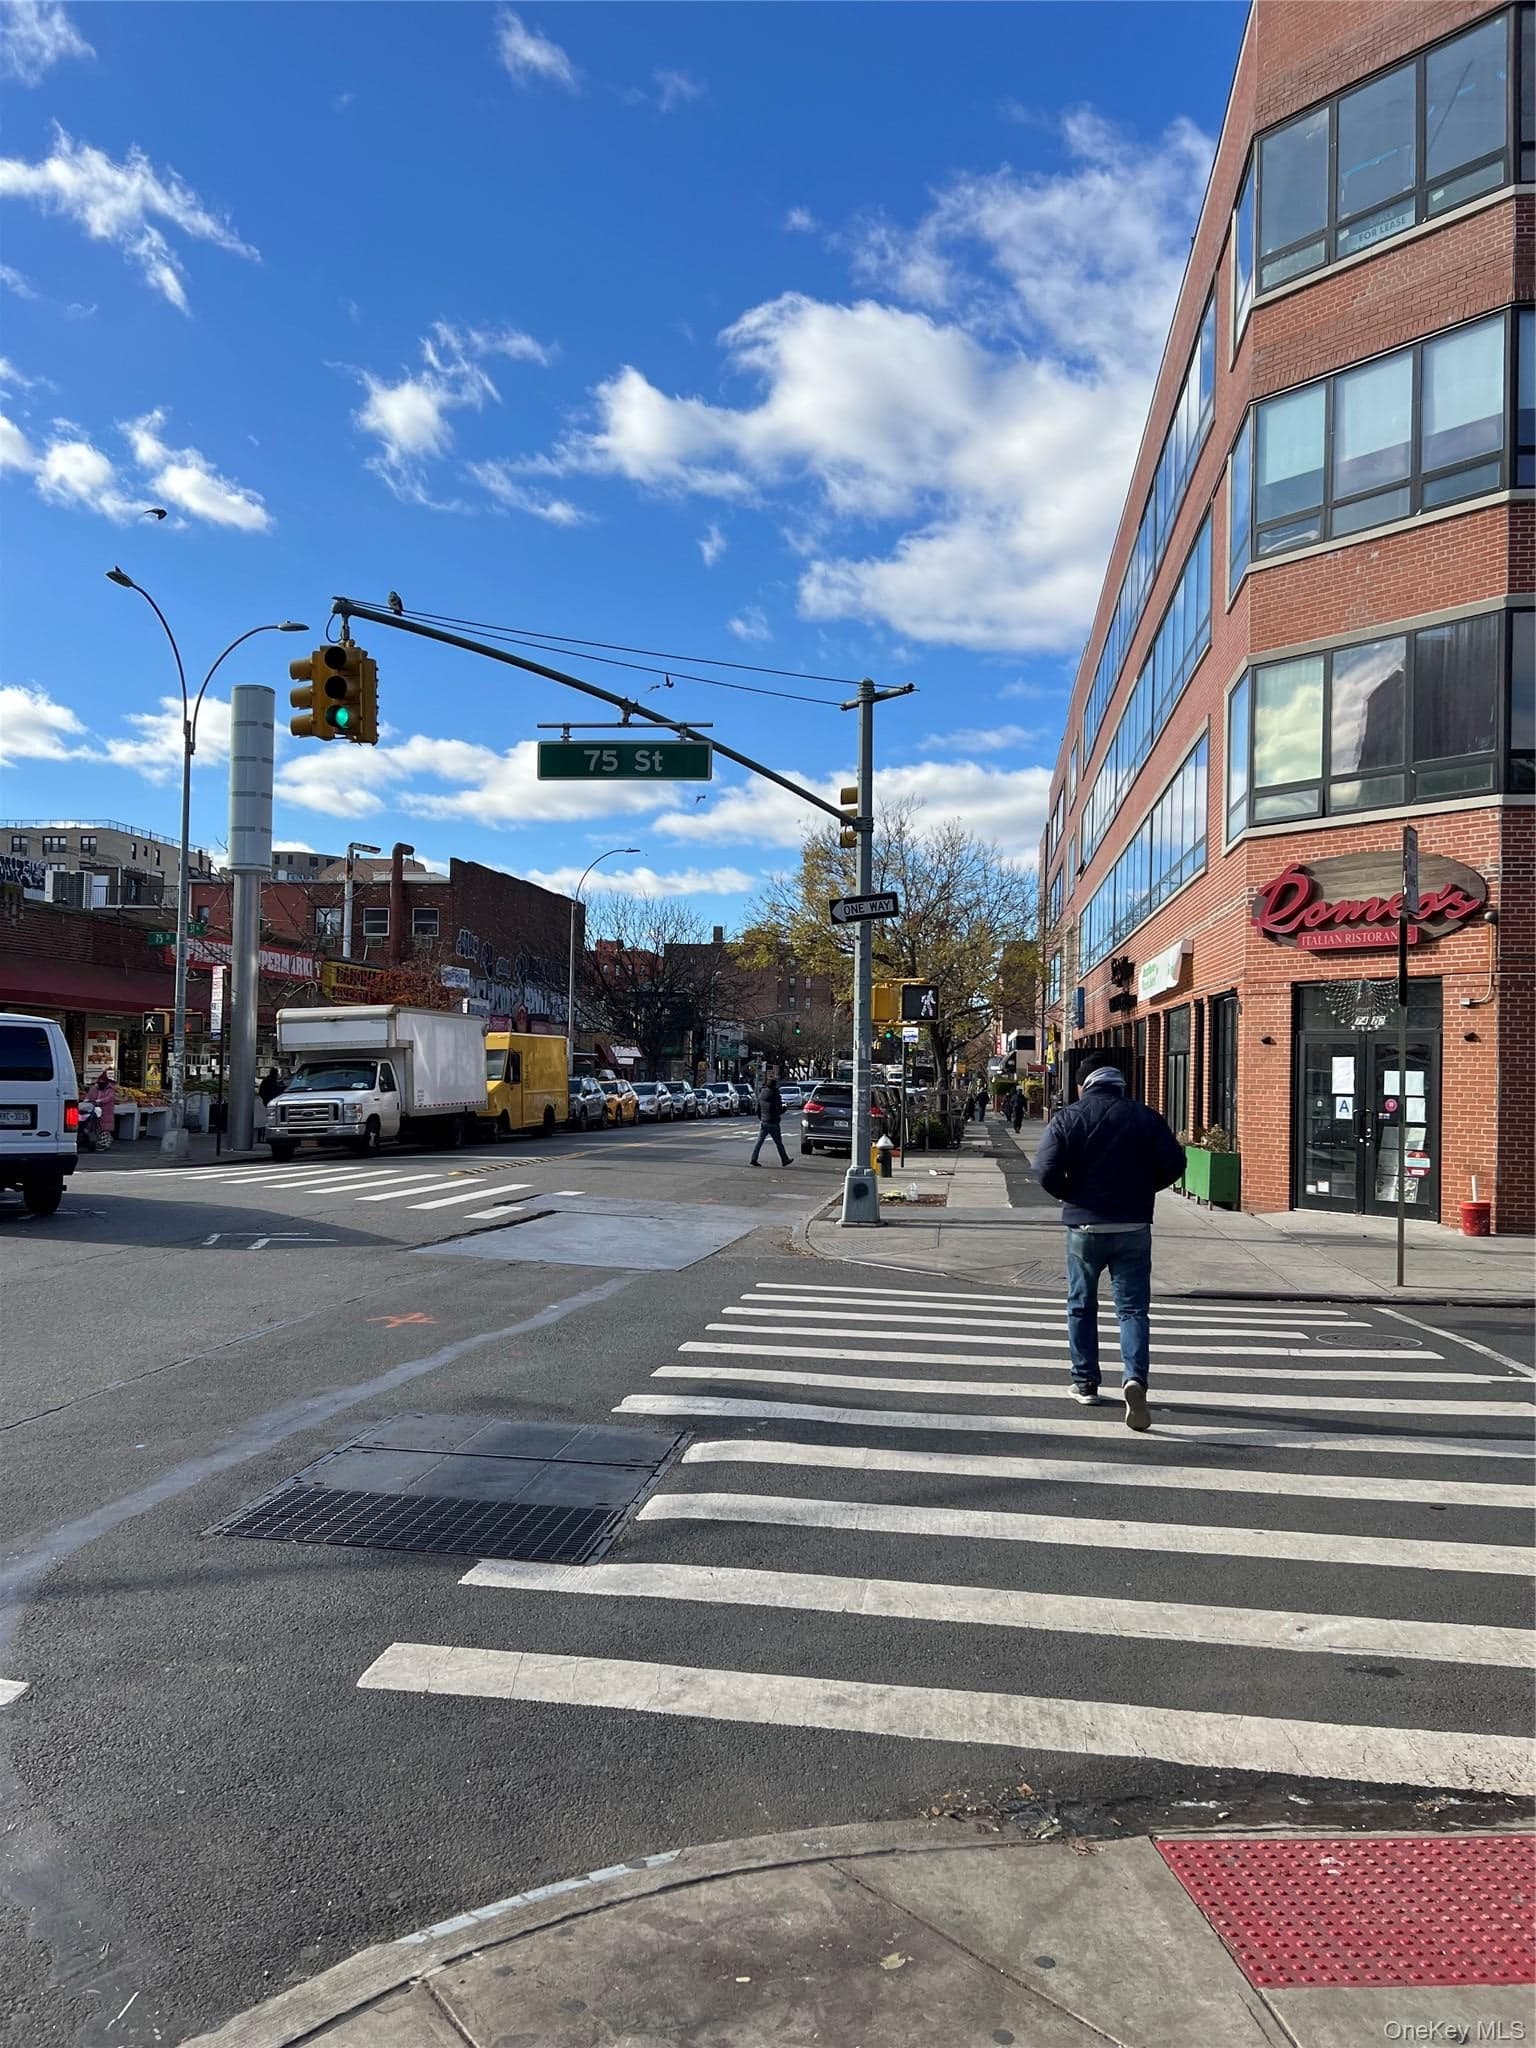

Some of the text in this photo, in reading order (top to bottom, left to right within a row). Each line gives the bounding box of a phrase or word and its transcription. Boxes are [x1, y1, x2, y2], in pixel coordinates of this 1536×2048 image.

[1359, 229, 1377, 242] FOR
[1380, 216, 1406, 233] LEASE
[583, 750, 663, 771] 75 St
[843, 900, 890, 915] ONE WAY
[1250, 863, 1480, 937] Romeo's
[155, 933, 164, 944] 75
[1302, 929, 1411, 946] ITALIAN RISTORANE
[1339, 1099, 1349, 1113] A
